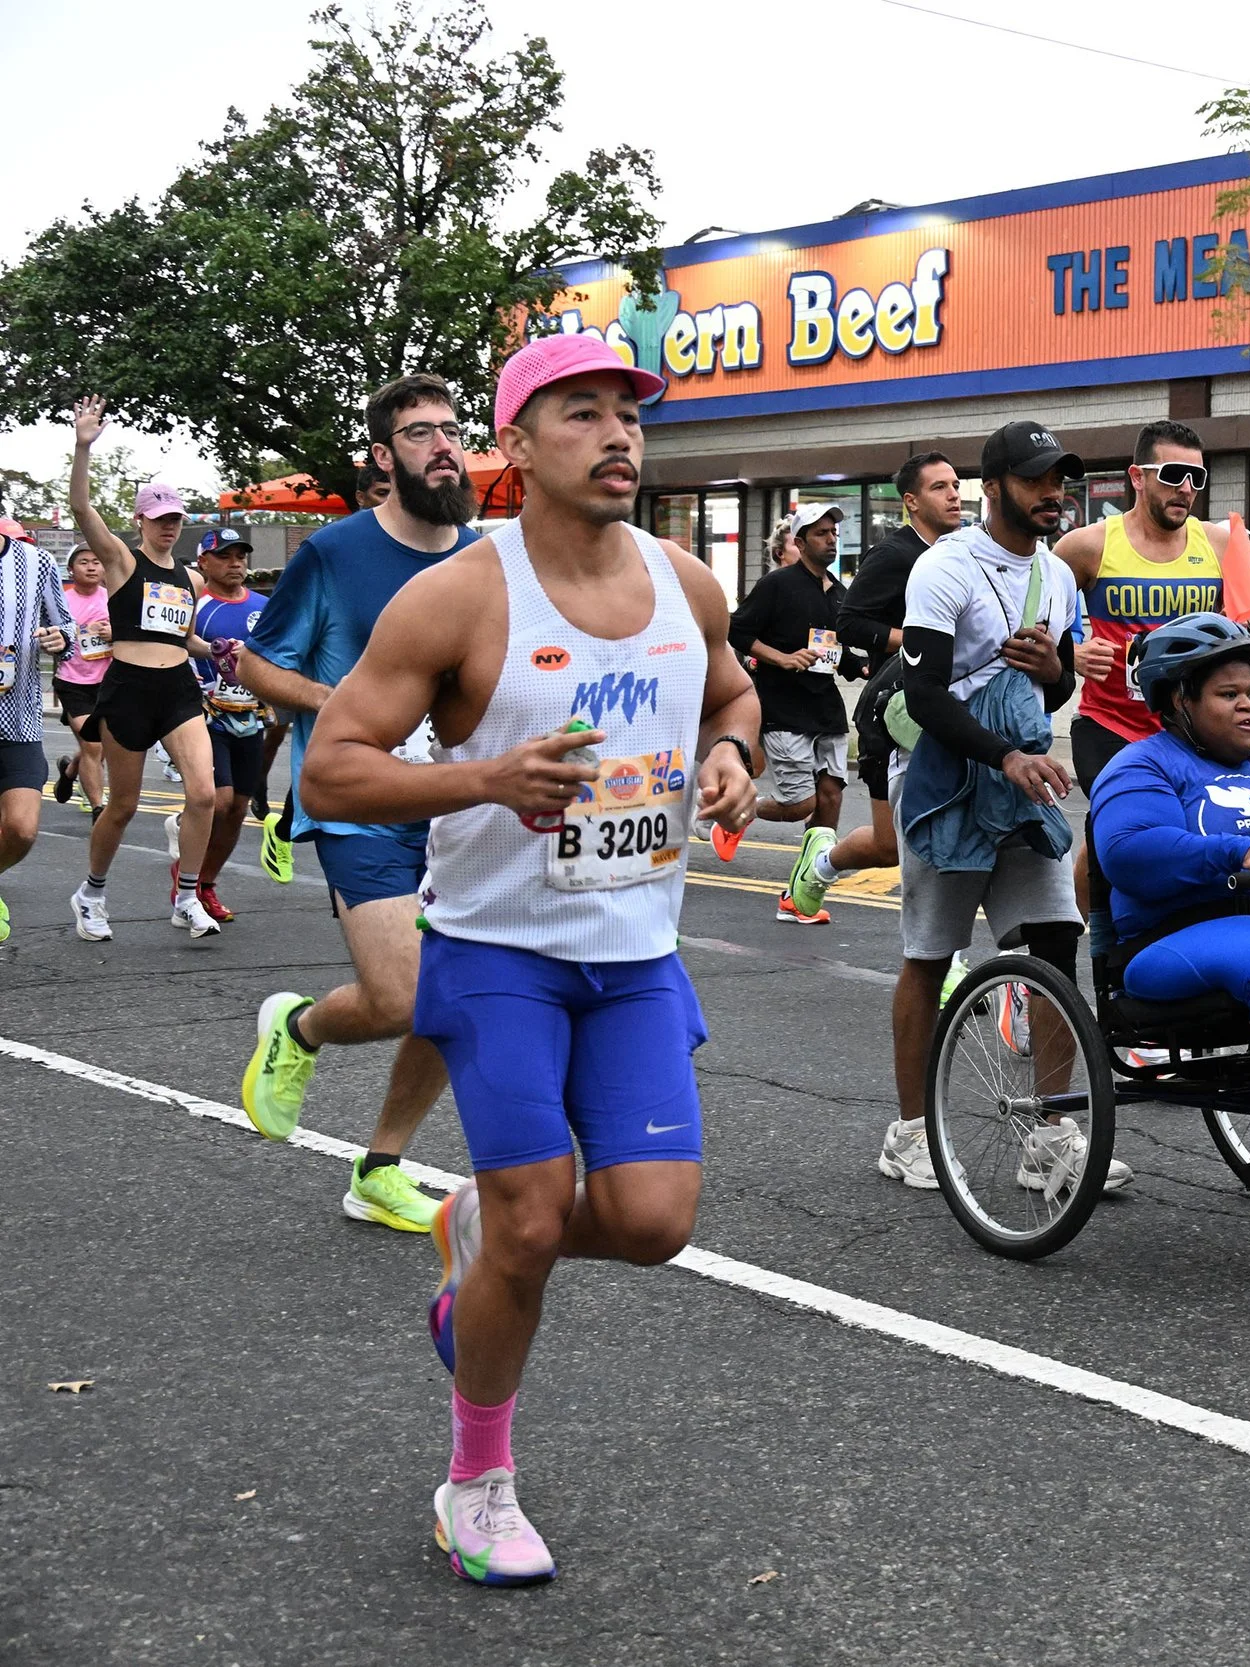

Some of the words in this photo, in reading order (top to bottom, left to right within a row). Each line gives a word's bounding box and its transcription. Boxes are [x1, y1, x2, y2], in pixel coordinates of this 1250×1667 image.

[1047, 245, 1130, 316] THE
[788, 248, 949, 366] Beef
[1105, 585, 1217, 617] COLOMBIA
[147, 605, 156, 619] C
[161, 606, 186, 625] 4010
[81, 639, 88, 648] C
[647, 642, 687, 656] CASTRO
[535, 653, 565, 664] NY
[558, 824, 582, 859] B
[597, 812, 668, 860] 3209
